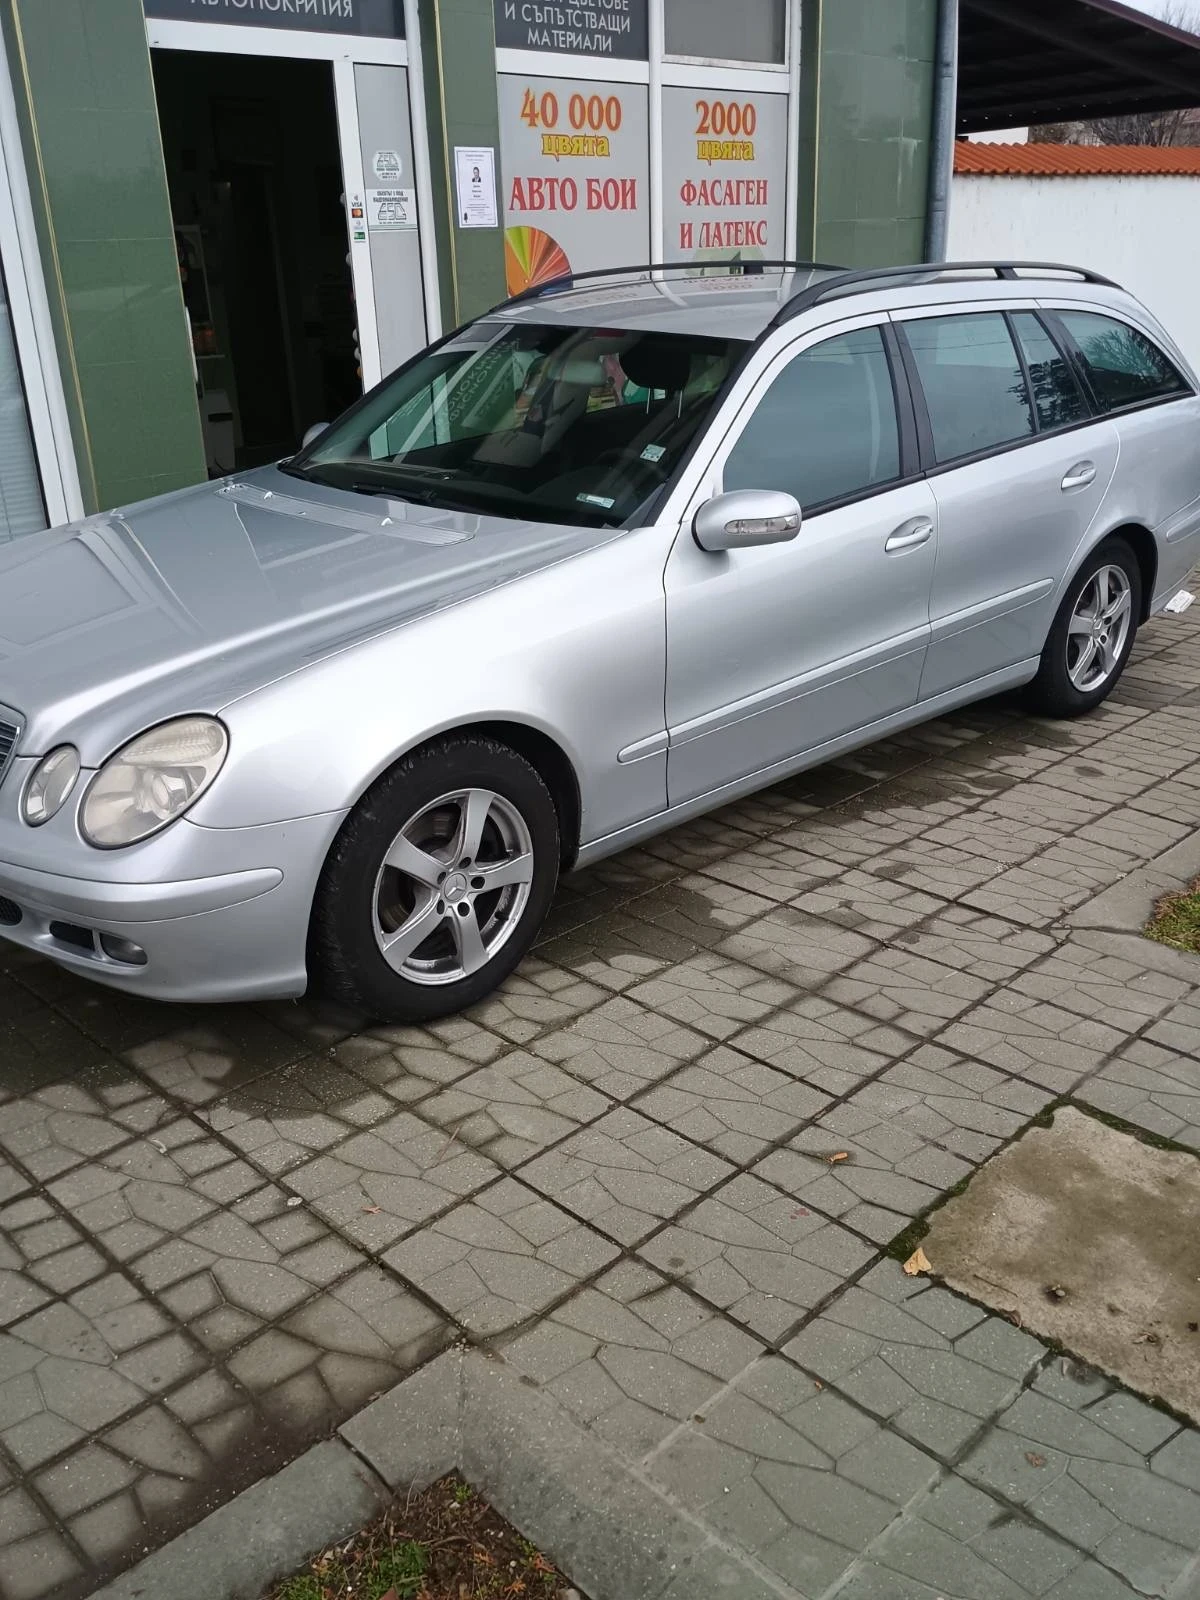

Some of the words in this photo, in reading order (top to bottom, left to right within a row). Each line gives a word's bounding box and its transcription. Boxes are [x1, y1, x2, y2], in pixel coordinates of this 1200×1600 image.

[190, 0, 354, 18] ПОКРИТИЯ
[504, 1, 516, 21] И
[521, 4, 631, 34] СЪПЪТСТВАЩИ
[527, 28, 613, 52] МАТЕРИАЛИ
[520, 87, 559, 129] 40
[568, 93, 622, 132] 000
[695, 100, 757, 136] 2000
[508, 176, 578, 211] АВТО
[585, 178, 637, 211] БОИ
[679, 179, 768, 206] ФАСАГЕН
[679, 222, 693, 249] И
[698, 220, 768, 248] ЛАТЕКС
